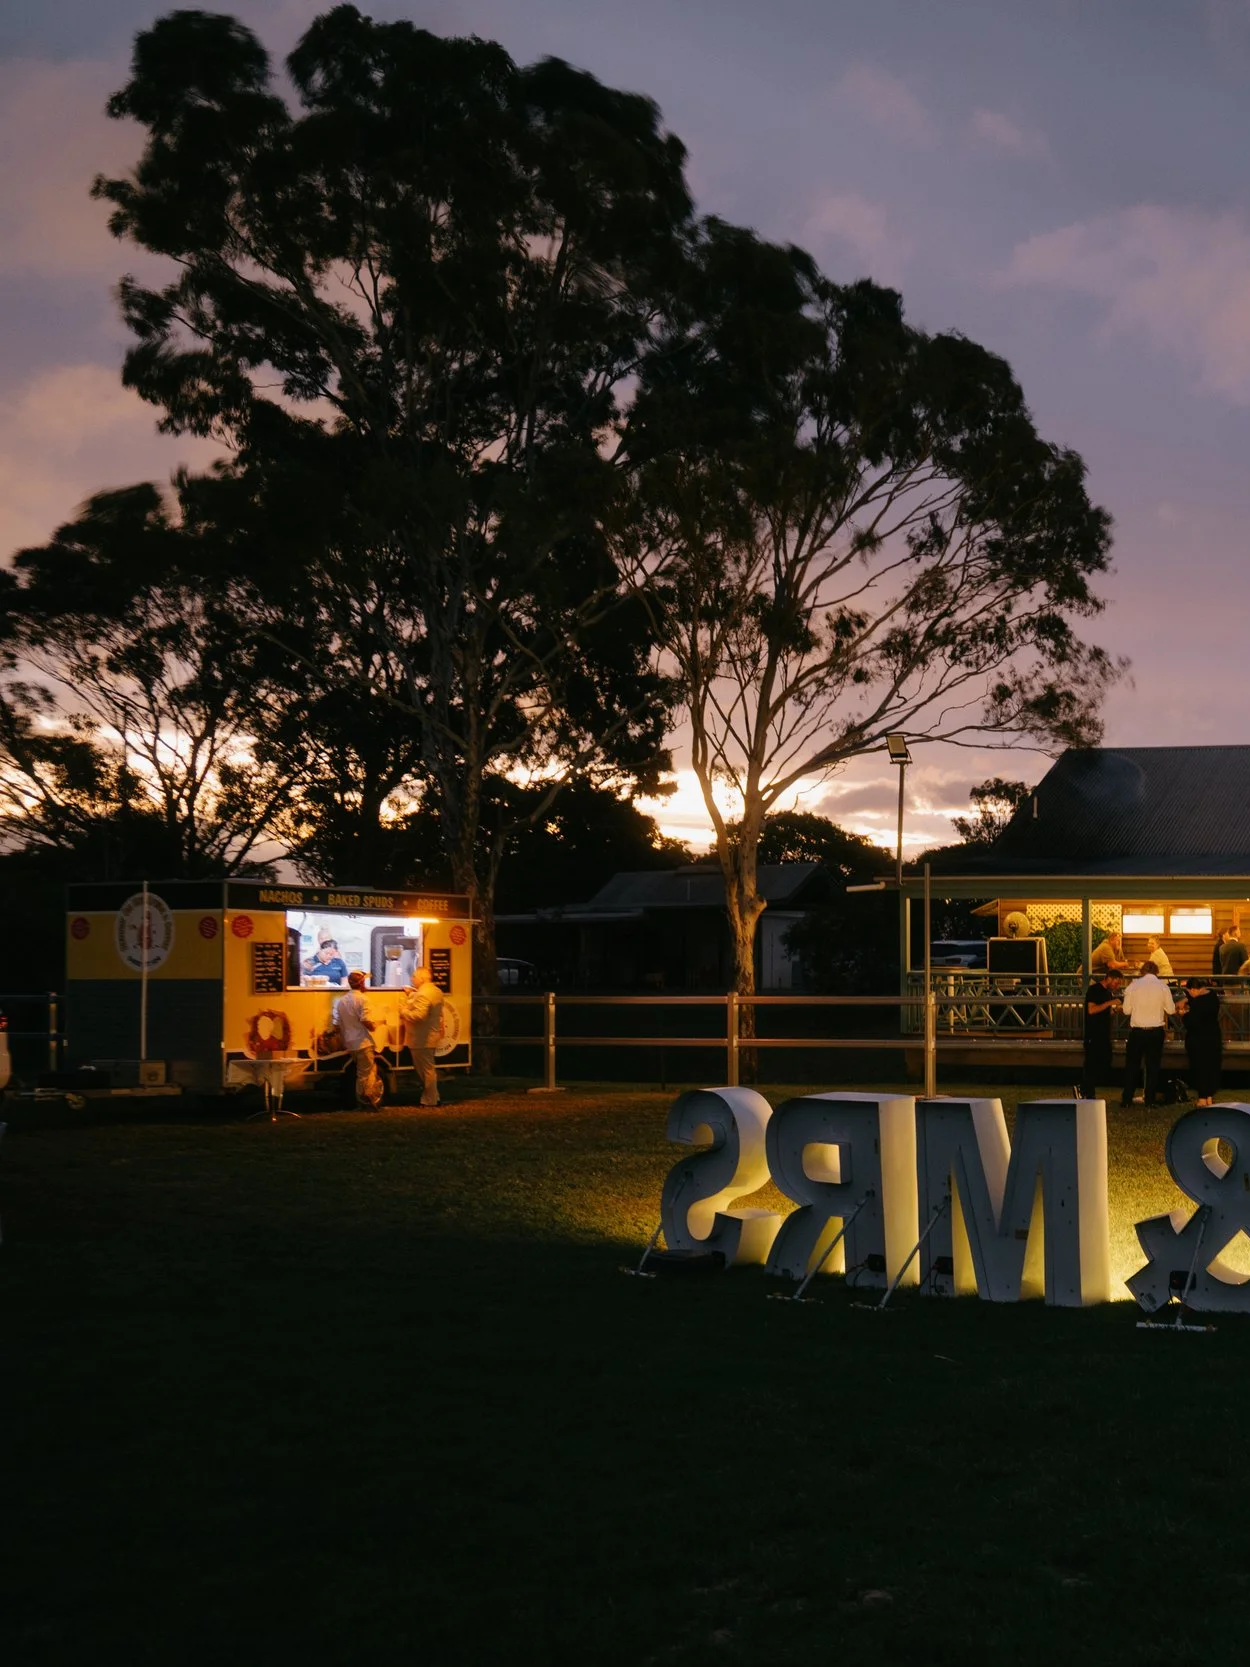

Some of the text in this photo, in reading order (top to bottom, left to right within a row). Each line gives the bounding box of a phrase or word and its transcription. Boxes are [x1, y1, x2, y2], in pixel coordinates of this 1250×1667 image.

[259, 889, 303, 905] NACHOS
[328, 893, 394, 909] BAKED SPUDS
[417, 898, 449, 912] COFFEE
